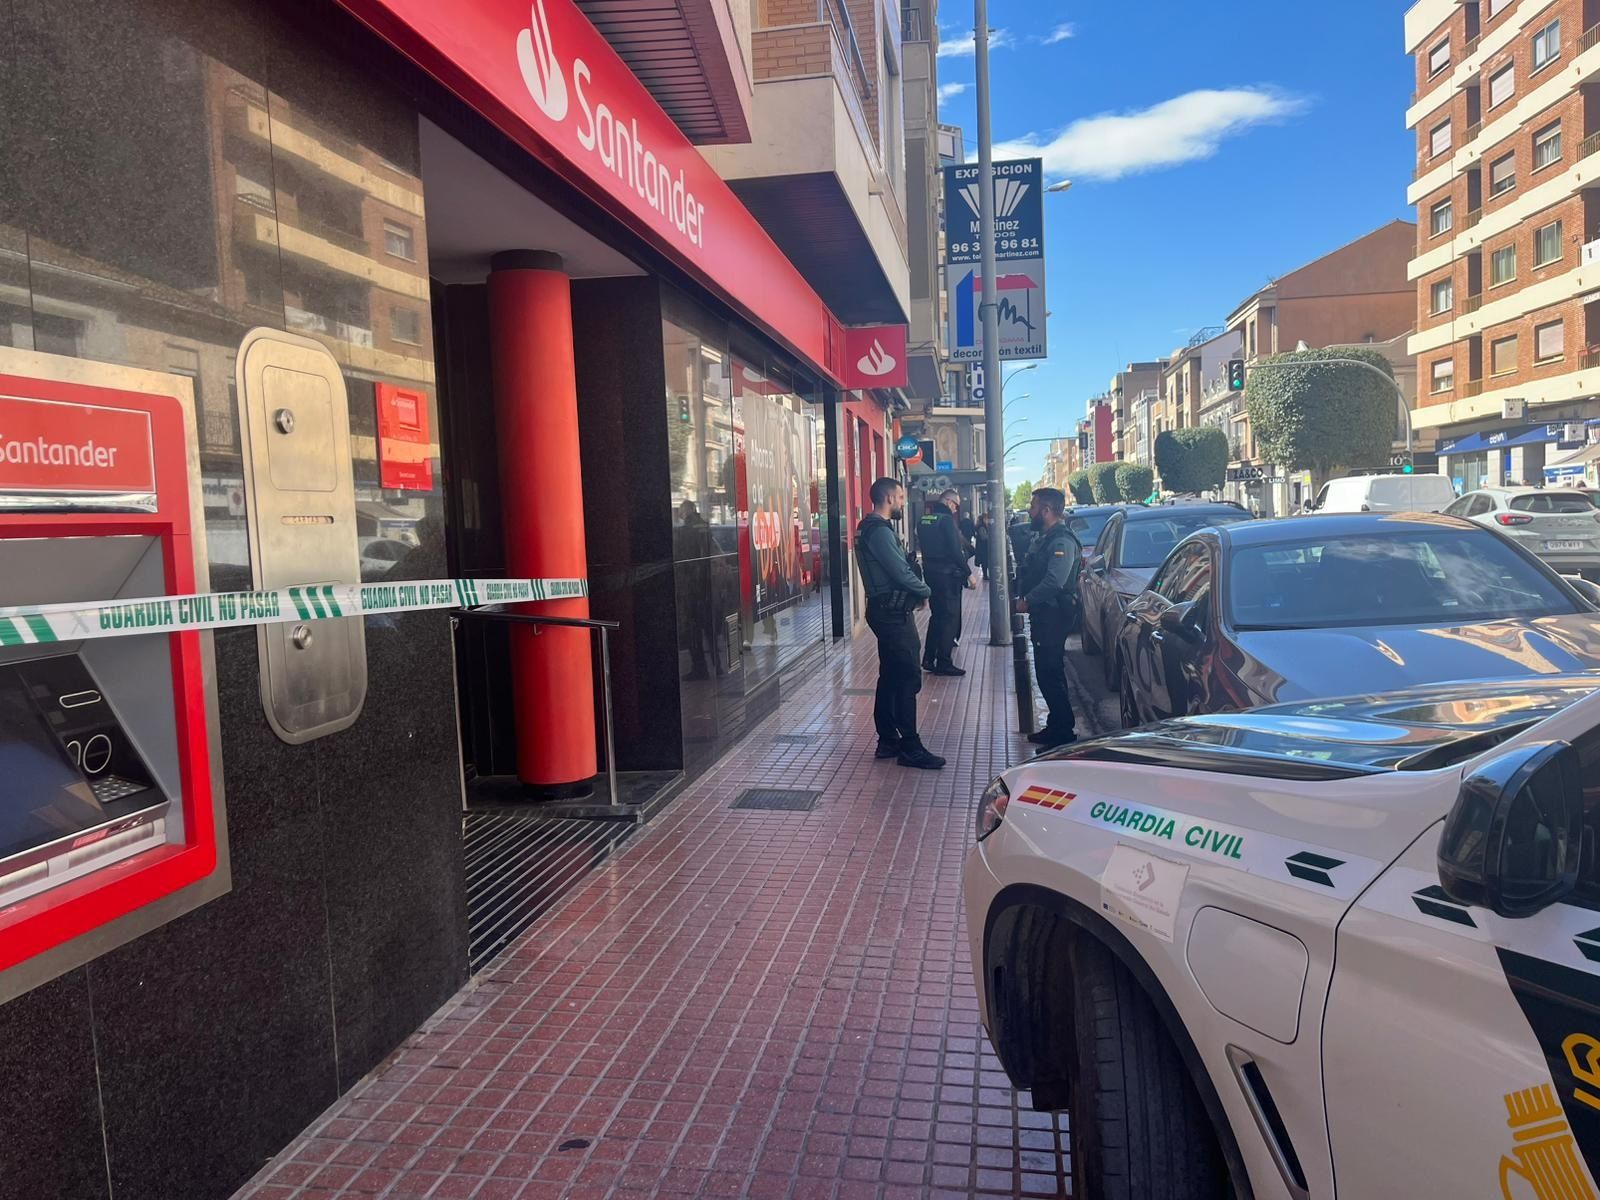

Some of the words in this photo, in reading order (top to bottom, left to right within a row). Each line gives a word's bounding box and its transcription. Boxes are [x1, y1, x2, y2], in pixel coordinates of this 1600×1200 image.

[573, 58, 704, 249] Santander
[955, 164, 1032, 179] EXPSICION
[952, 242, 969, 253] 96
[1000, 239, 1018, 250] 96
[1021, 237, 1039, 248] 81
[1014, 344, 1041, 355] textil
[360, 586, 397, 610] GUARDIA
[398, 585, 418, 607] CIVIL
[419, 584, 430, 605] NO
[431, 583, 453, 604] PASAR
[100, 600, 173, 630] GUARDIA
[178, 596, 215, 624] CIVIL
[218, 593, 236, 620] NO
[240, 591, 280, 619] PASAR
[1090, 801, 1176, 840] GUARDIA
[1185, 825, 1244, 859] CIVIL
